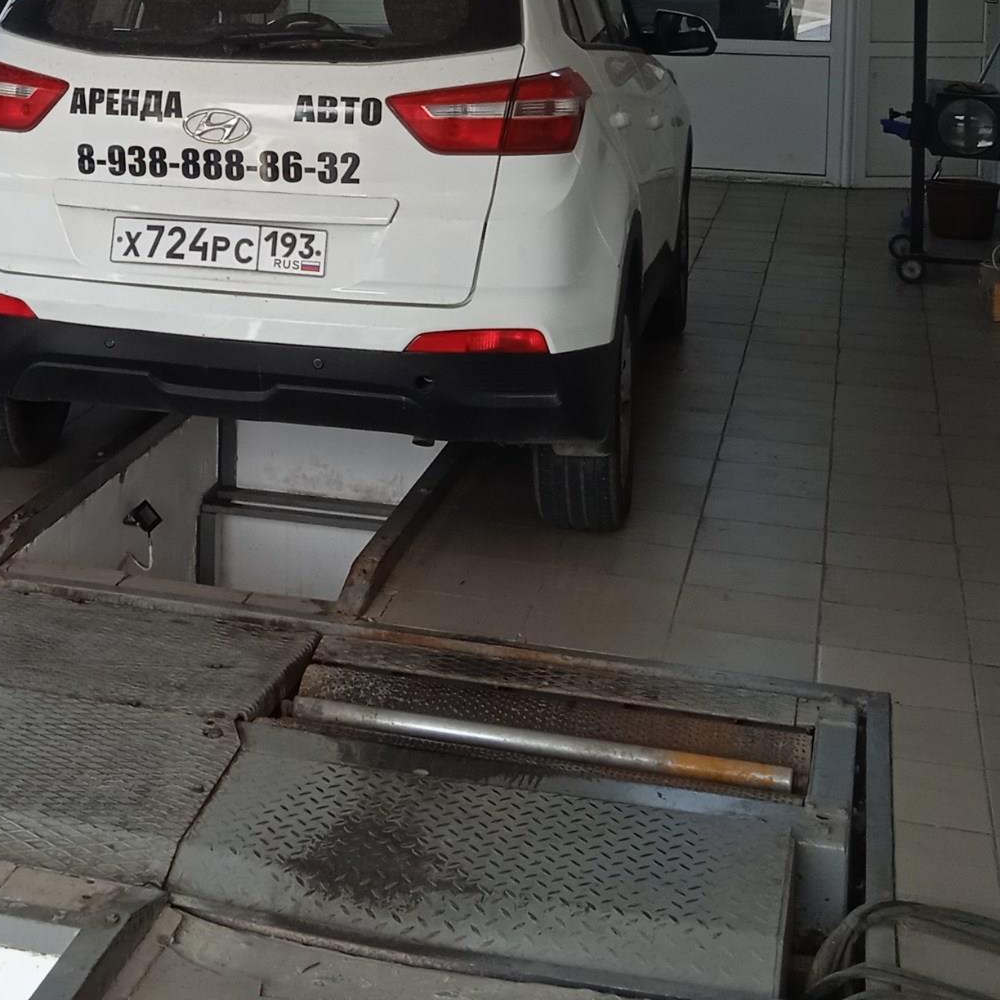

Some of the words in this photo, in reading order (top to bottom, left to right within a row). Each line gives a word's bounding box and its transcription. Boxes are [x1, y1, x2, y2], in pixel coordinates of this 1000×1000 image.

[70, 87, 183, 122] АРЕНДА
[293, 94, 383, 126] АВТО
[77, 143, 361, 185] 8-938-888-86-32
[122, 224, 254, 264] Х724РС
[264, 231, 315, 260] 193
[273, 258, 300, 270] RUS
